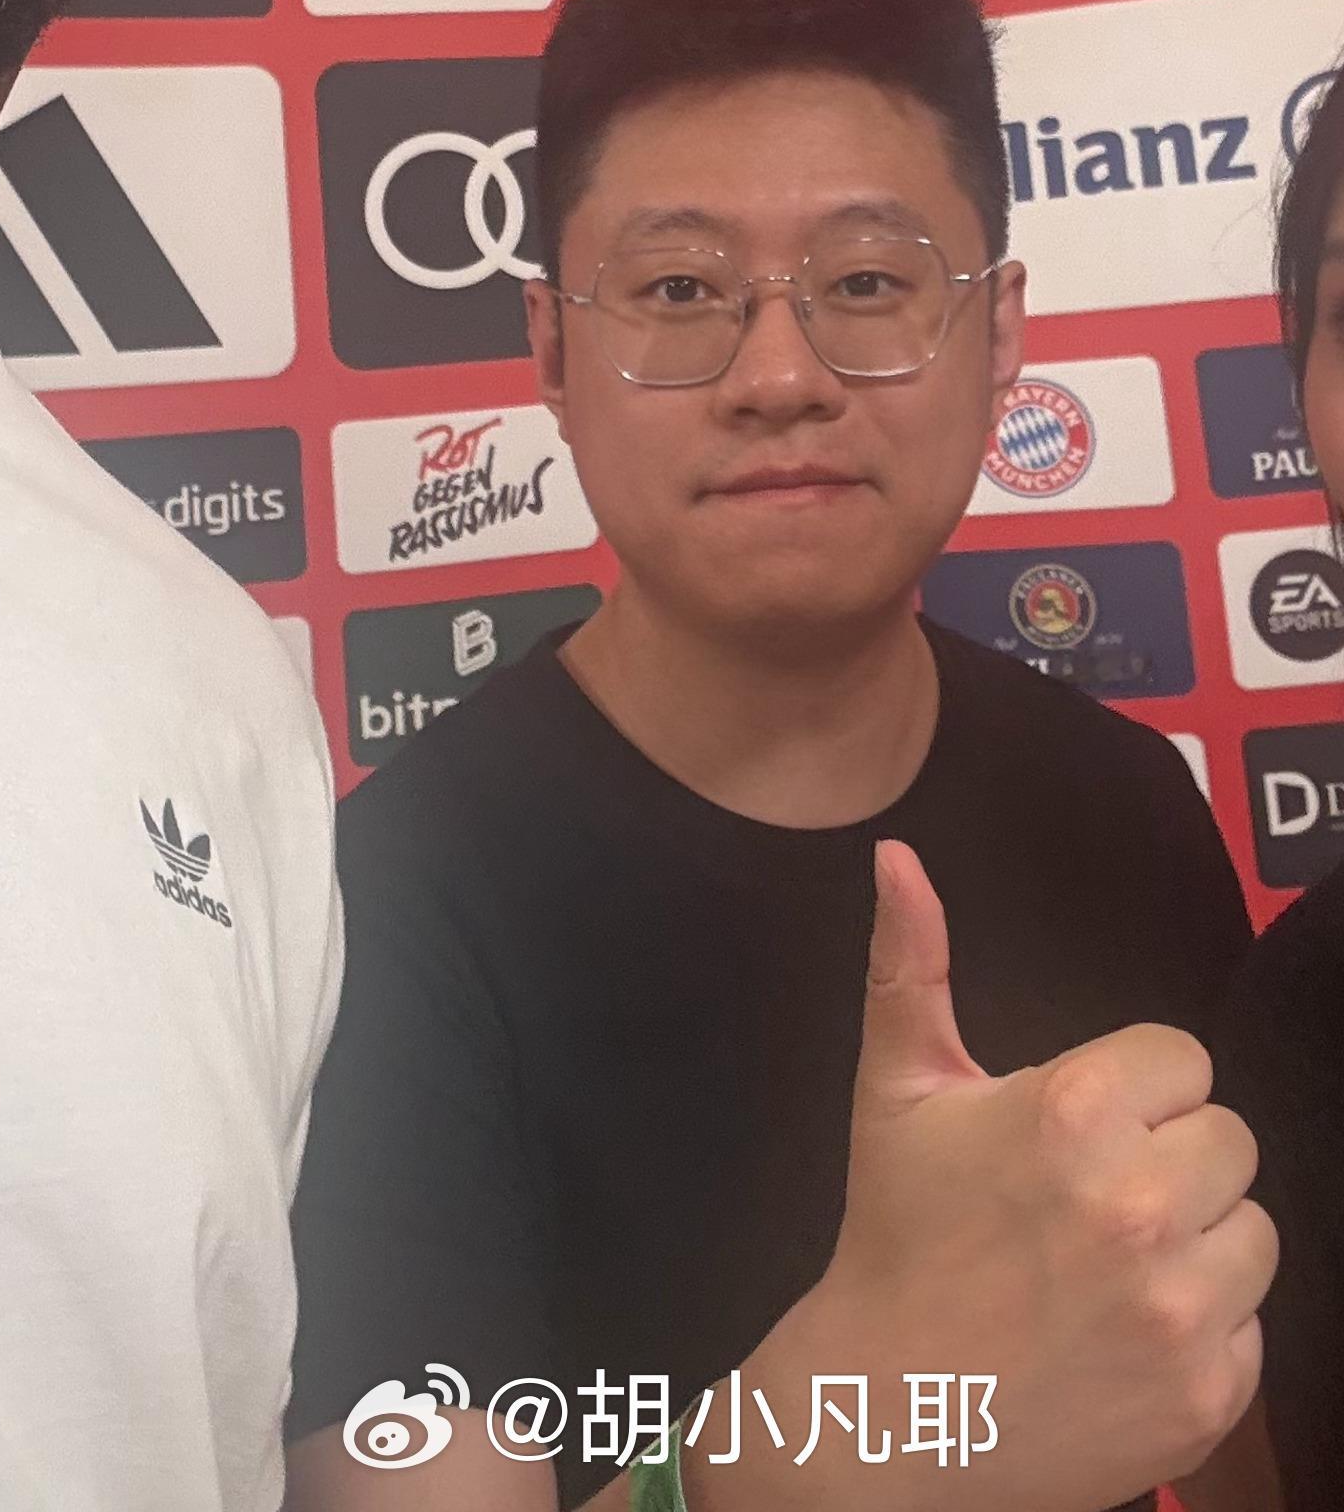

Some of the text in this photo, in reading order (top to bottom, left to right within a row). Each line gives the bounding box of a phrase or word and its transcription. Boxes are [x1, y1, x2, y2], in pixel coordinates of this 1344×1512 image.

[413, 443, 496, 514] GEGEN
[414, 417, 504, 484] ROT
[163, 479, 286, 537] digits
[388, 456, 554, 563] RASSISMUS
[1269, 572, 1344, 615] EA
[153, 869, 233, 928] adidas
